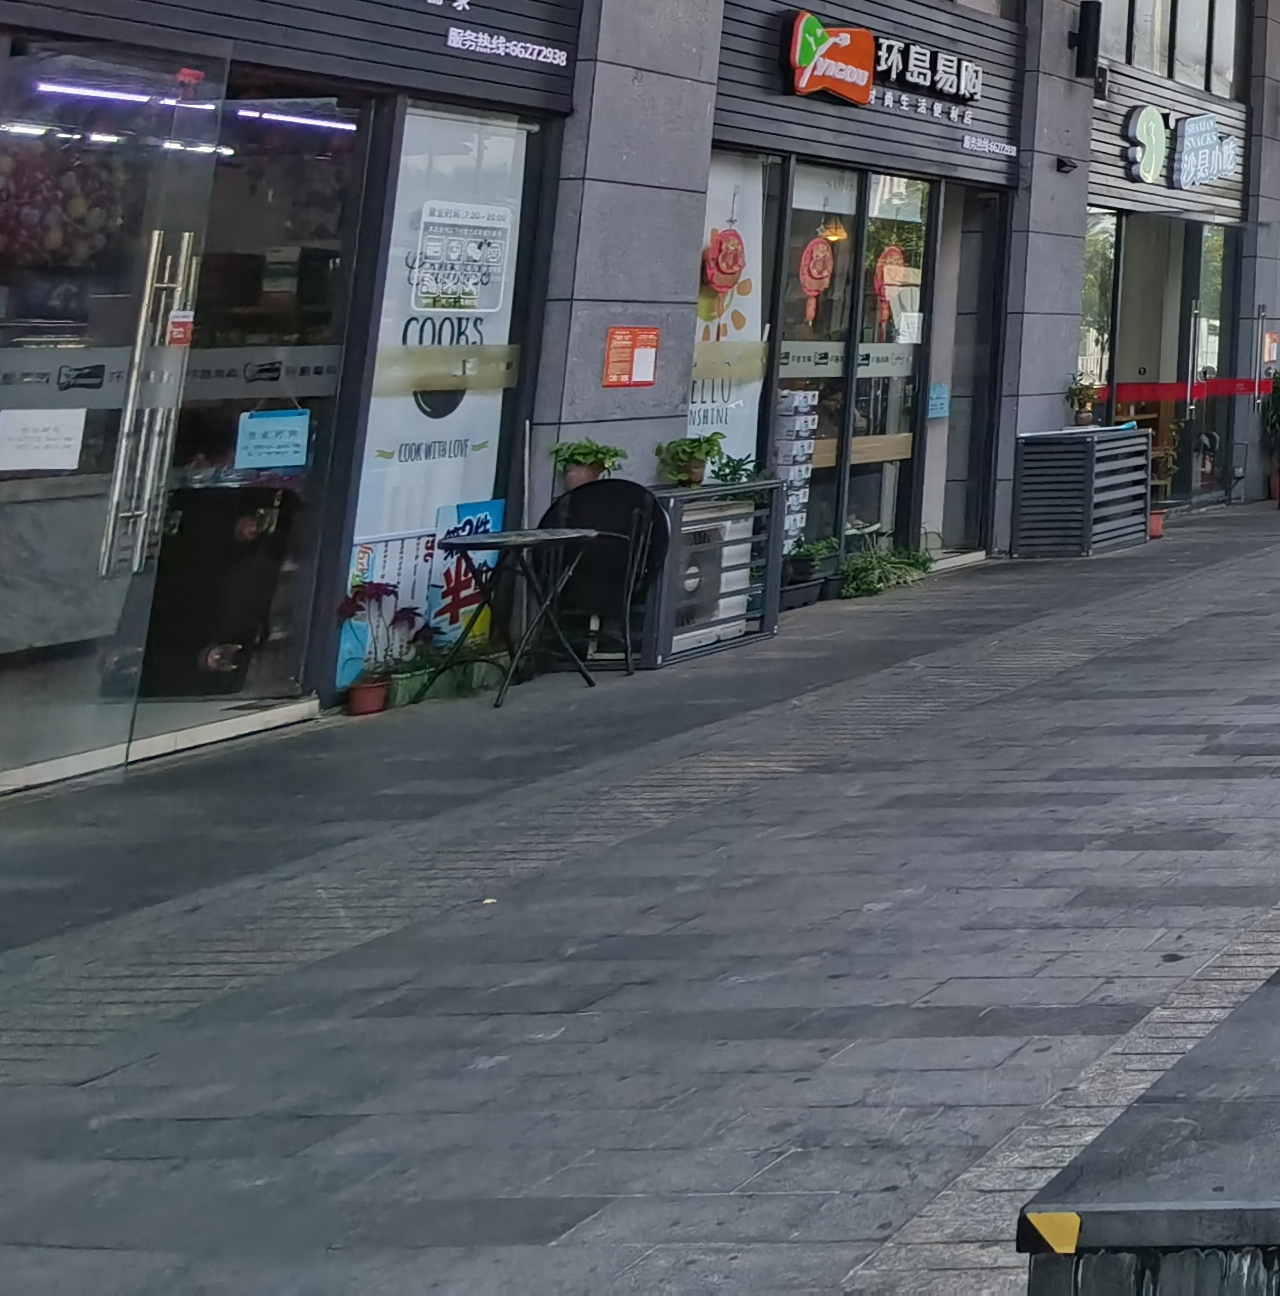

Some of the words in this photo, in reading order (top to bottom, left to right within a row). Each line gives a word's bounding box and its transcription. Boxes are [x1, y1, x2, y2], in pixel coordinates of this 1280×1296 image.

[876, 37, 984, 101] 环岛易购
[1183, 141, 1237, 183] 沙县小吃
